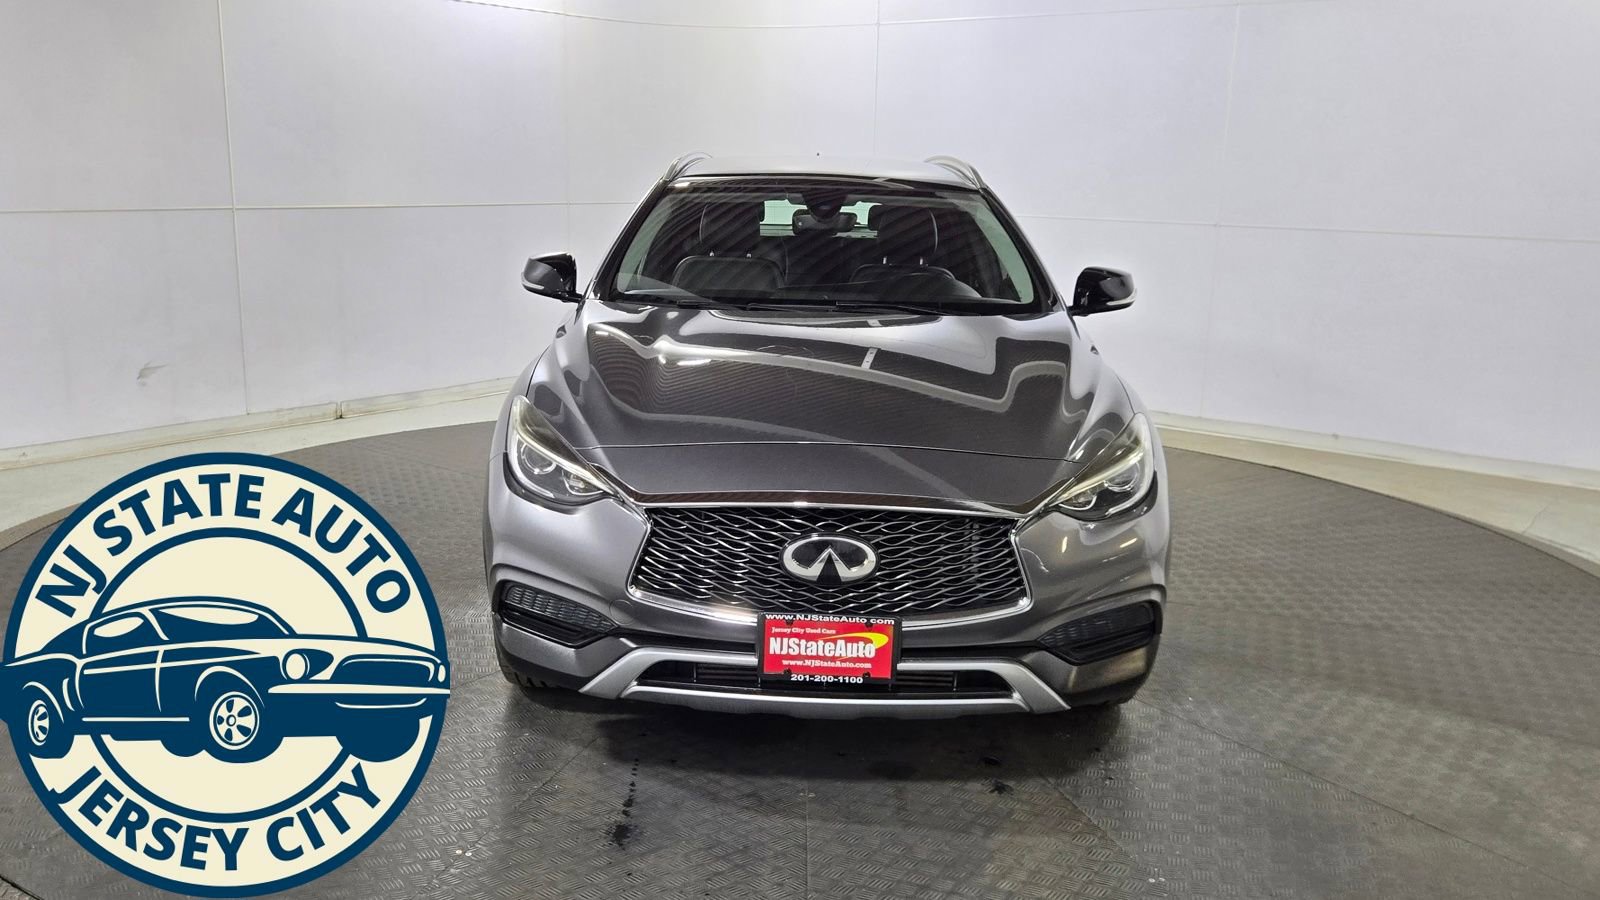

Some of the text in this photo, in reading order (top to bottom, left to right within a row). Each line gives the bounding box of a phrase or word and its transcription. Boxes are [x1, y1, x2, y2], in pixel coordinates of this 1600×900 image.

[769, 637, 876, 658] NJStateAuto
[781, 659, 872, 669] www.NJStateAuto.com
[790, 674, 864, 684] 201-200-1100
